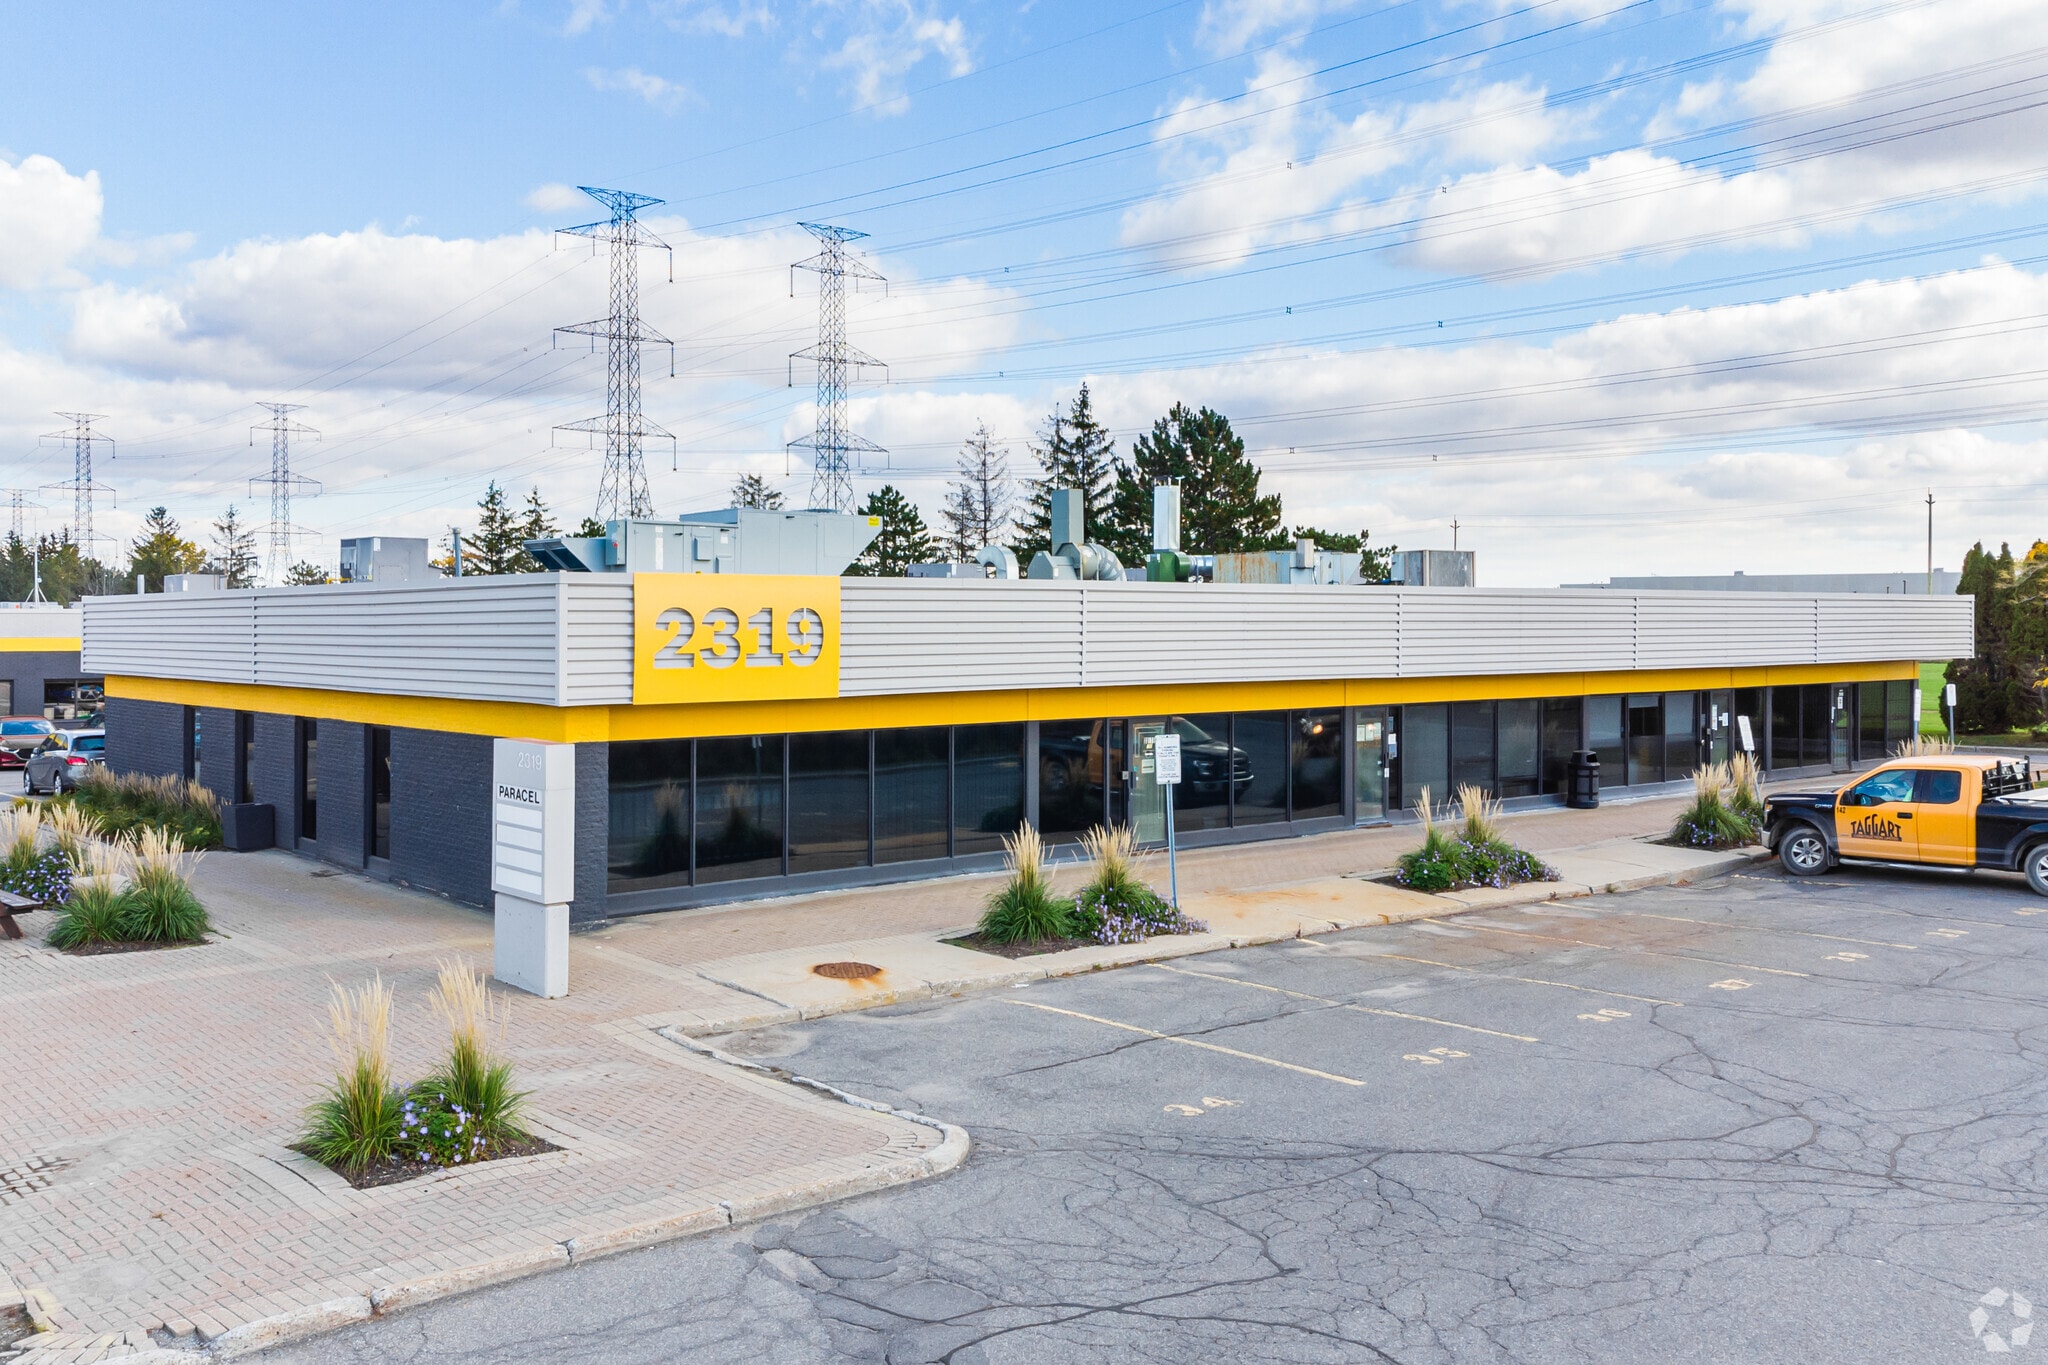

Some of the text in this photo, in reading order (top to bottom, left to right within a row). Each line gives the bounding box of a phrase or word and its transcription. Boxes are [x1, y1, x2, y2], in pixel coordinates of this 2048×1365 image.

[654, 607, 825, 669] 2319
[518, 752, 542, 770] 2319
[499, 785, 540, 804] PARACEL
[1836, 806, 1846, 814] 142
[1850, 813, 1902, 839] TAGGART
